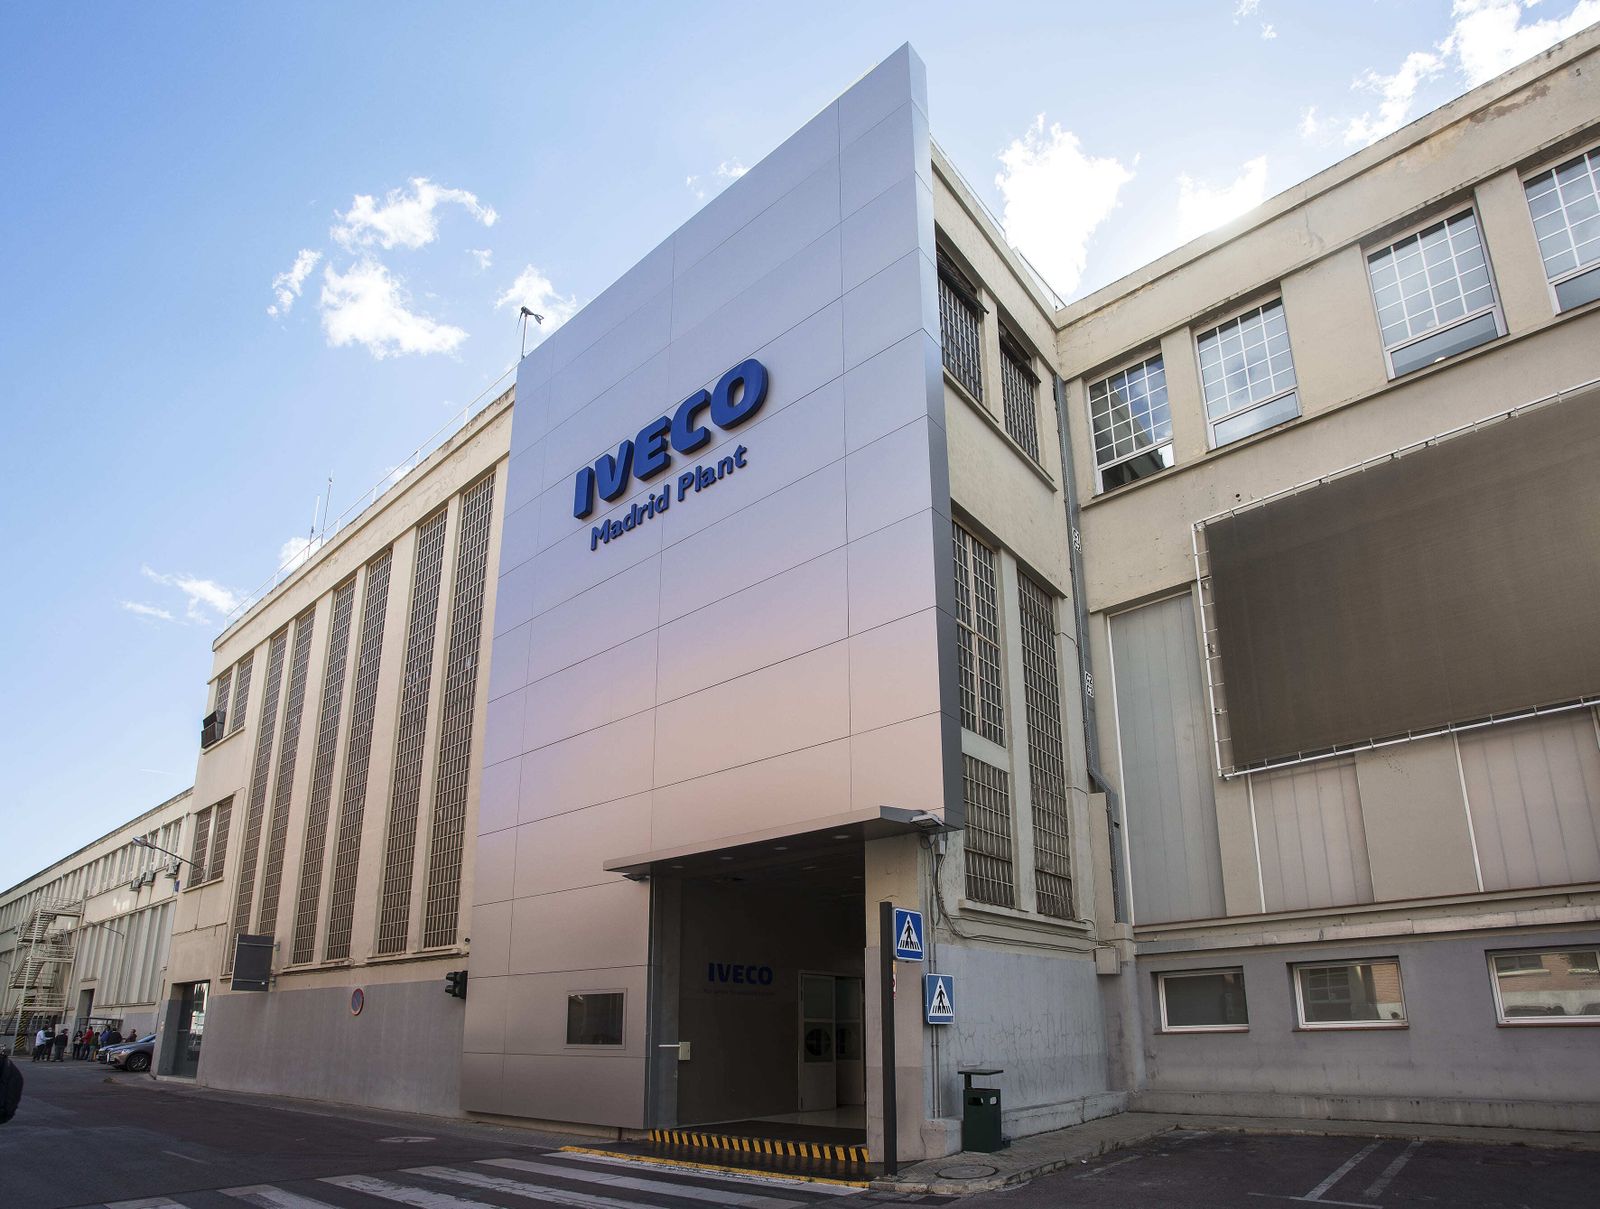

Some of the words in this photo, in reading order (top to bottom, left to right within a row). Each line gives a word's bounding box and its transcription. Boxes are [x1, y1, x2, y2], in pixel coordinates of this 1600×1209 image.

[573, 358, 769, 520] IVECO
[590, 484, 671, 552] Madrid
[677, 444, 748, 502] Plant
[708, 962, 773, 984] IVECO
